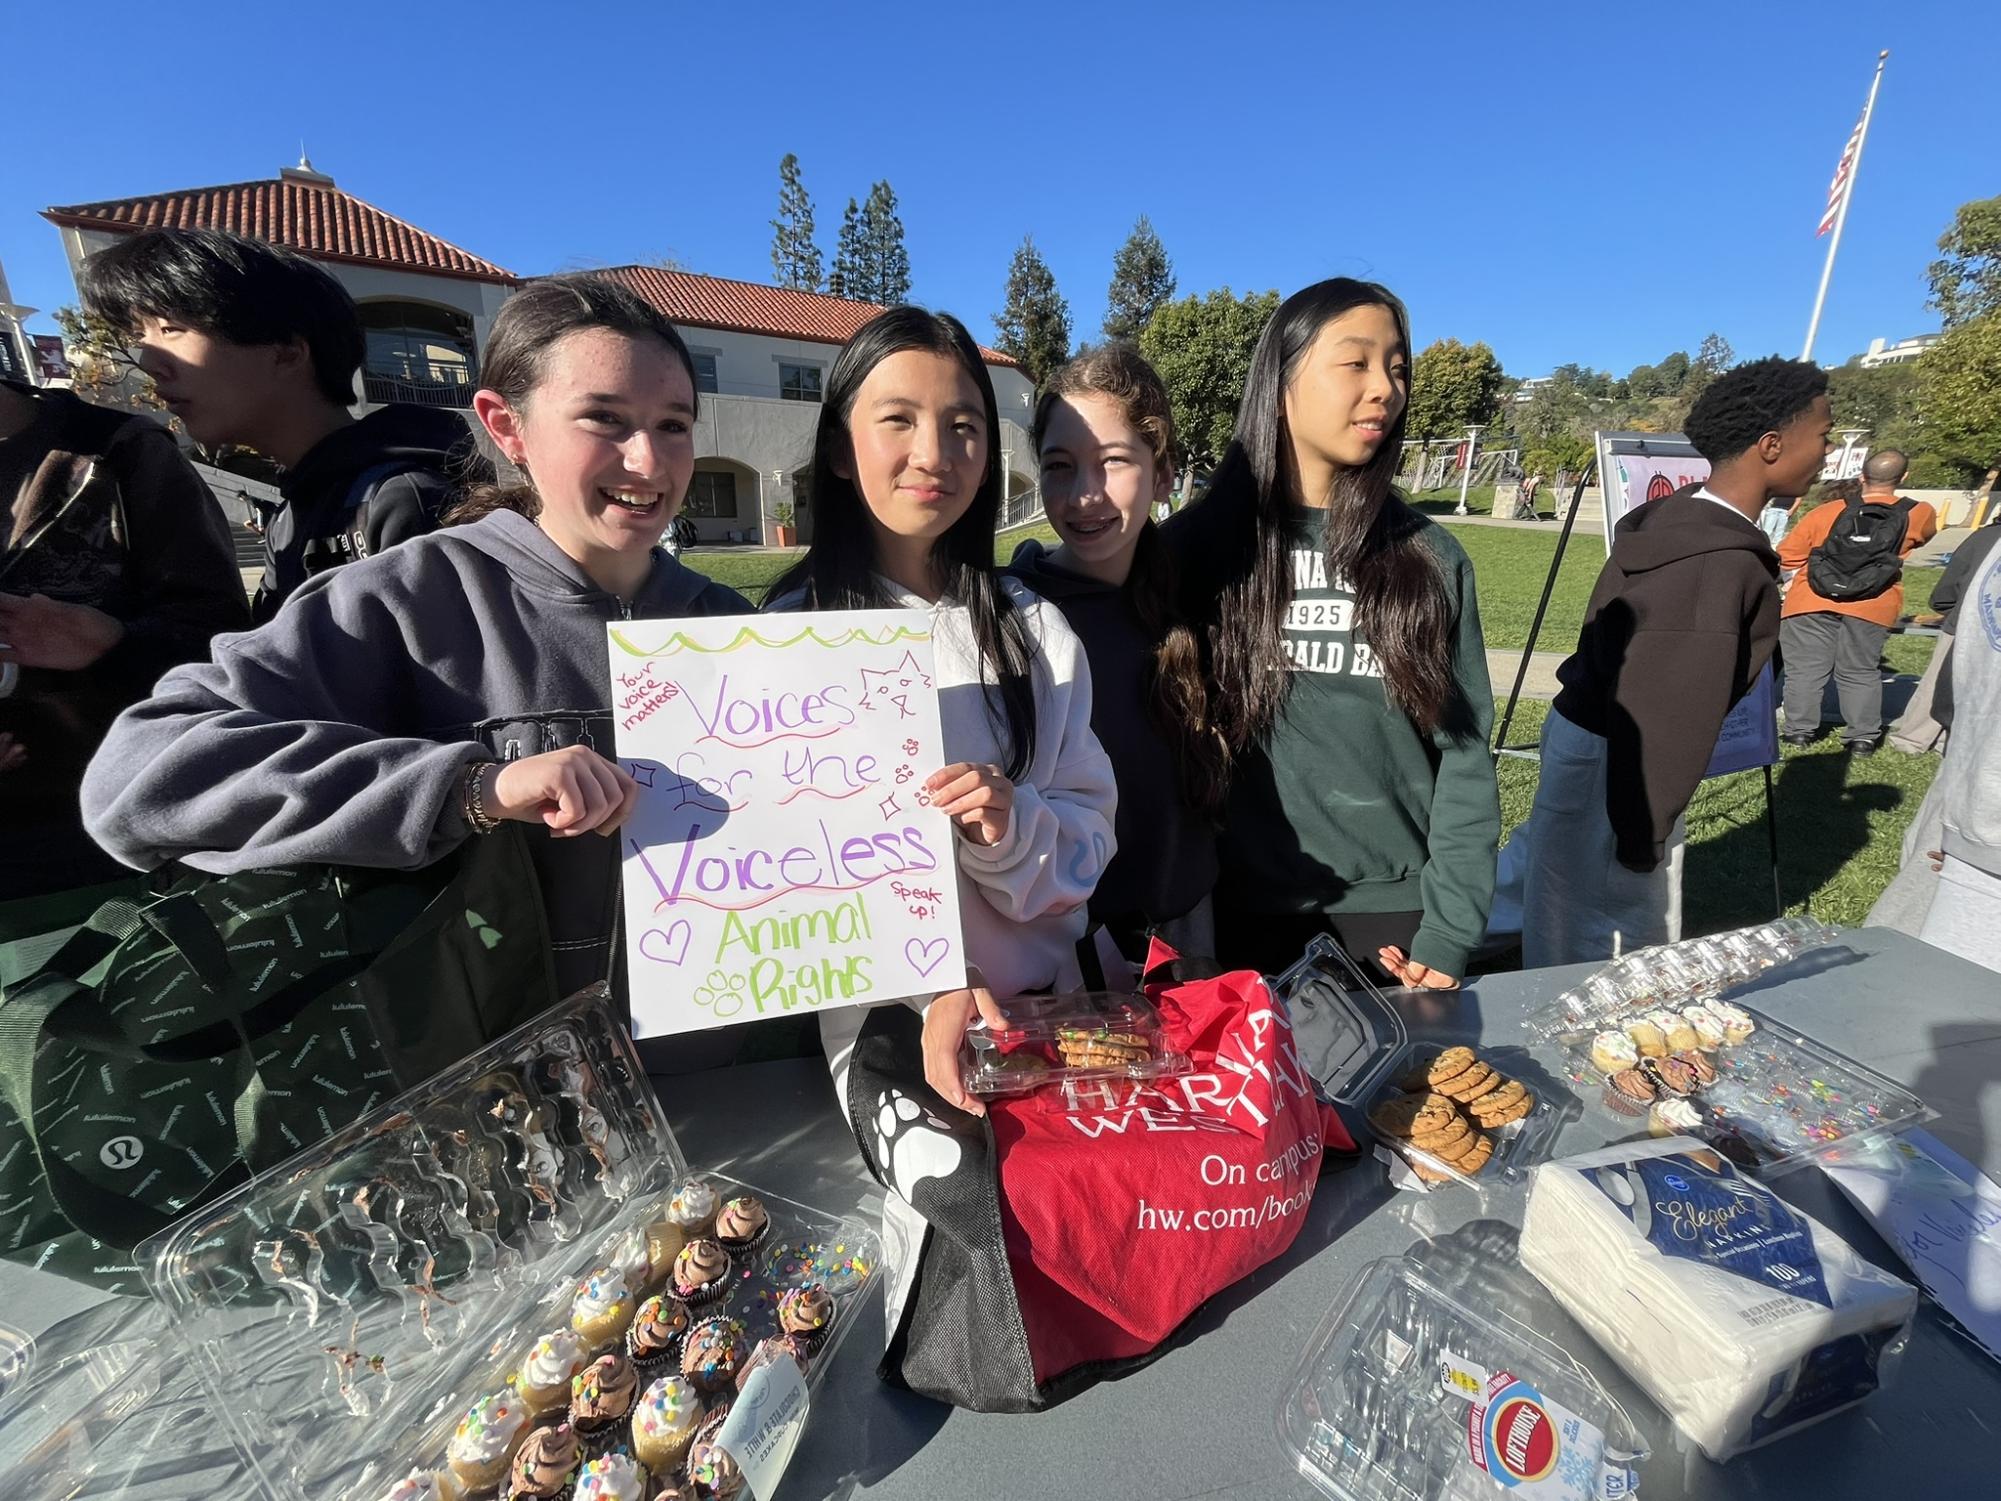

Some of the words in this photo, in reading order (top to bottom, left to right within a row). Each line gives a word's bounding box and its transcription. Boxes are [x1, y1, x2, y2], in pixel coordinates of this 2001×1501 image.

[1288, 605, 1341, 625] 1925
[616, 661, 654, 688] Your
[618, 679, 663, 709] voice
[621, 681, 679, 731] matters!
[674, 673, 856, 737] Voices
[665, 751, 753, 803] for
[781, 746, 882, 788] the
[629, 818, 938, 905] Voiceless
[890, 880, 942, 905] Speak
[908, 903, 937, 920] up!
[714, 891, 873, 965] Animal
[749, 954, 874, 1013] Rights
[1200, 1155, 1246, 1186] On
[1137, 1179, 1318, 1232] hw.com/book
[1655, 1195, 1753, 1241] Elegant
[1765, 1262, 1801, 1282] 100
[1505, 1404, 1542, 1473] LOFTHOUSE
